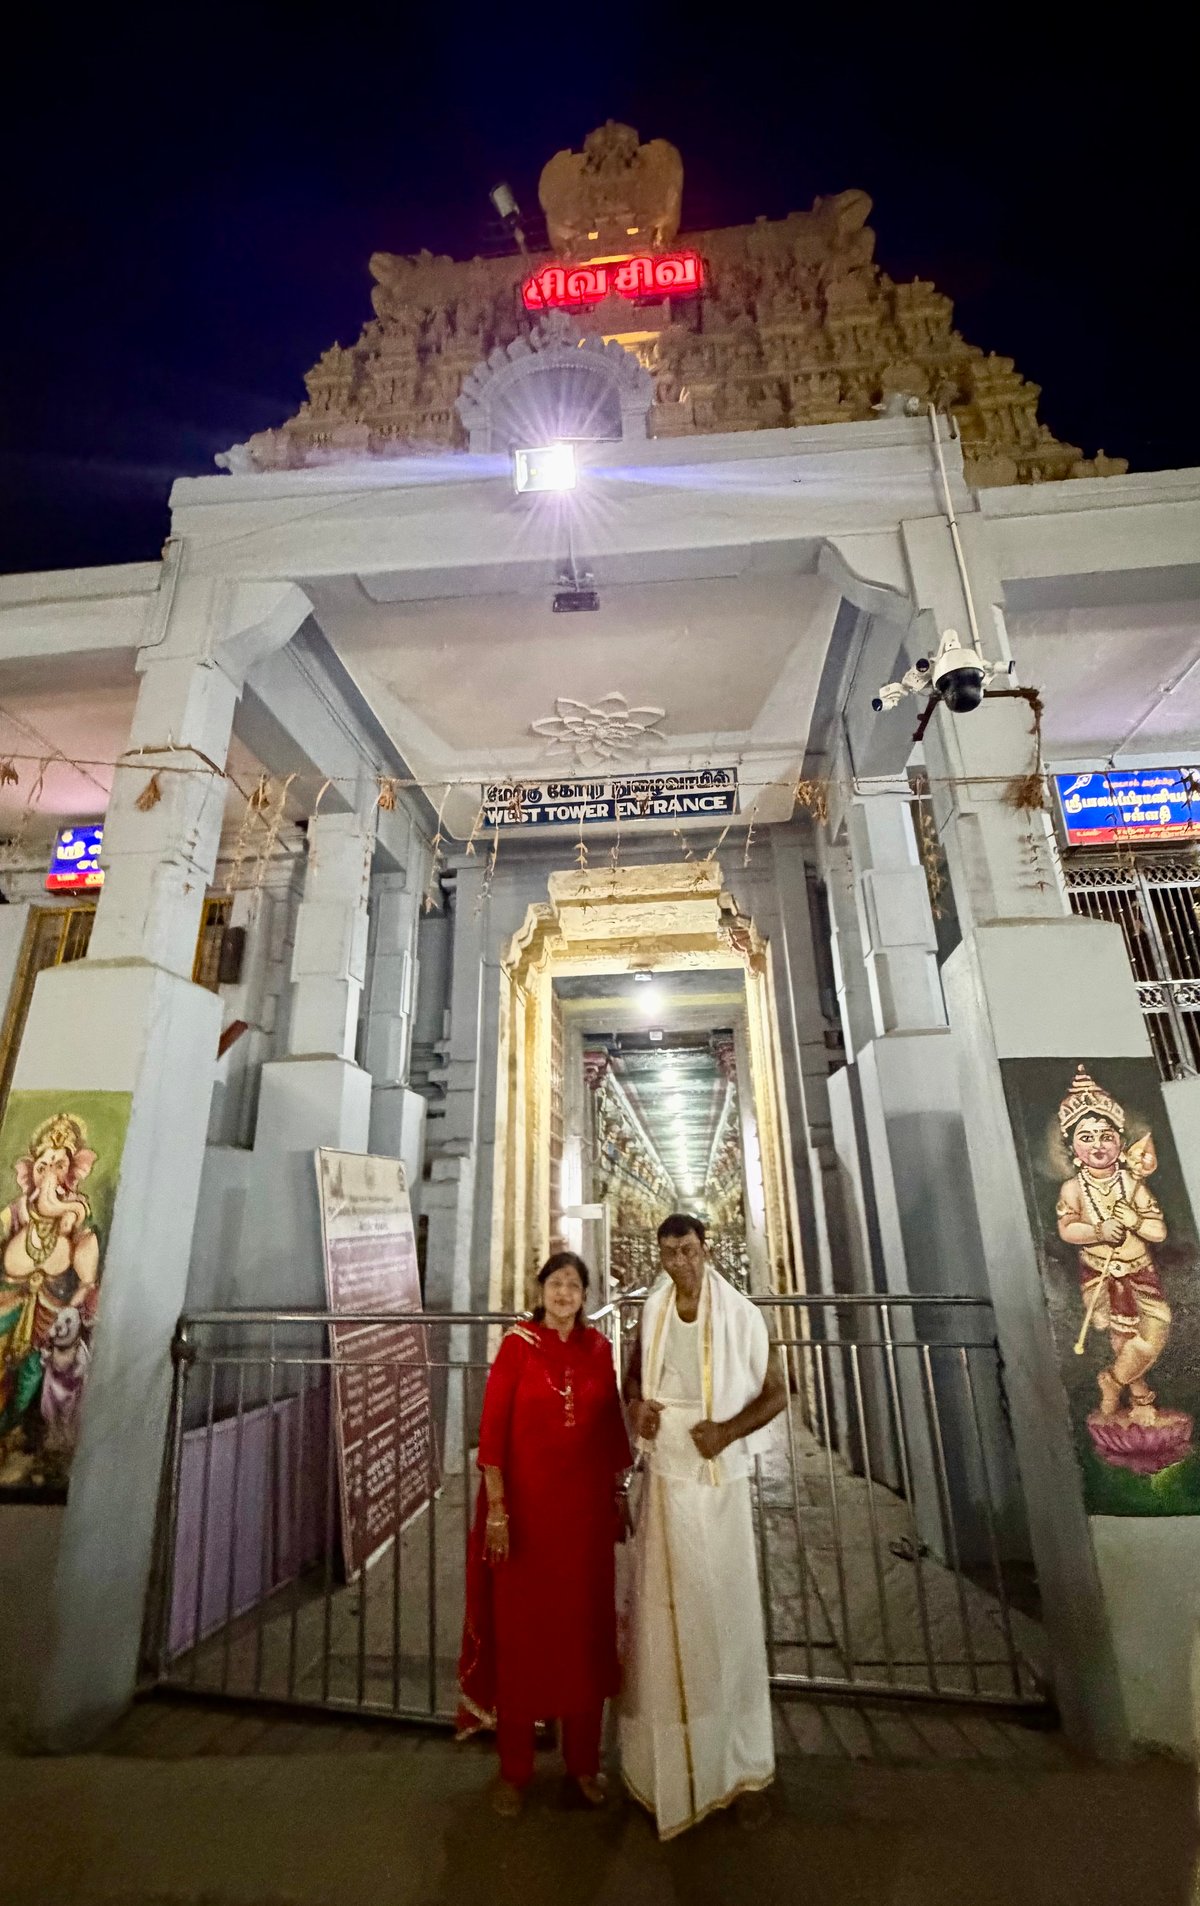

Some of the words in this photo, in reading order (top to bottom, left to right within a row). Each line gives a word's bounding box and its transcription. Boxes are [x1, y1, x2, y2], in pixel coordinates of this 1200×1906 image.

[525, 267, 607, 305] சிவ
[613, 257, 698, 294] சிவ
[487, 808, 541, 824] WEST
[545, 803, 609, 820] TOWER
[618, 796, 728, 816] ENTRANCE
